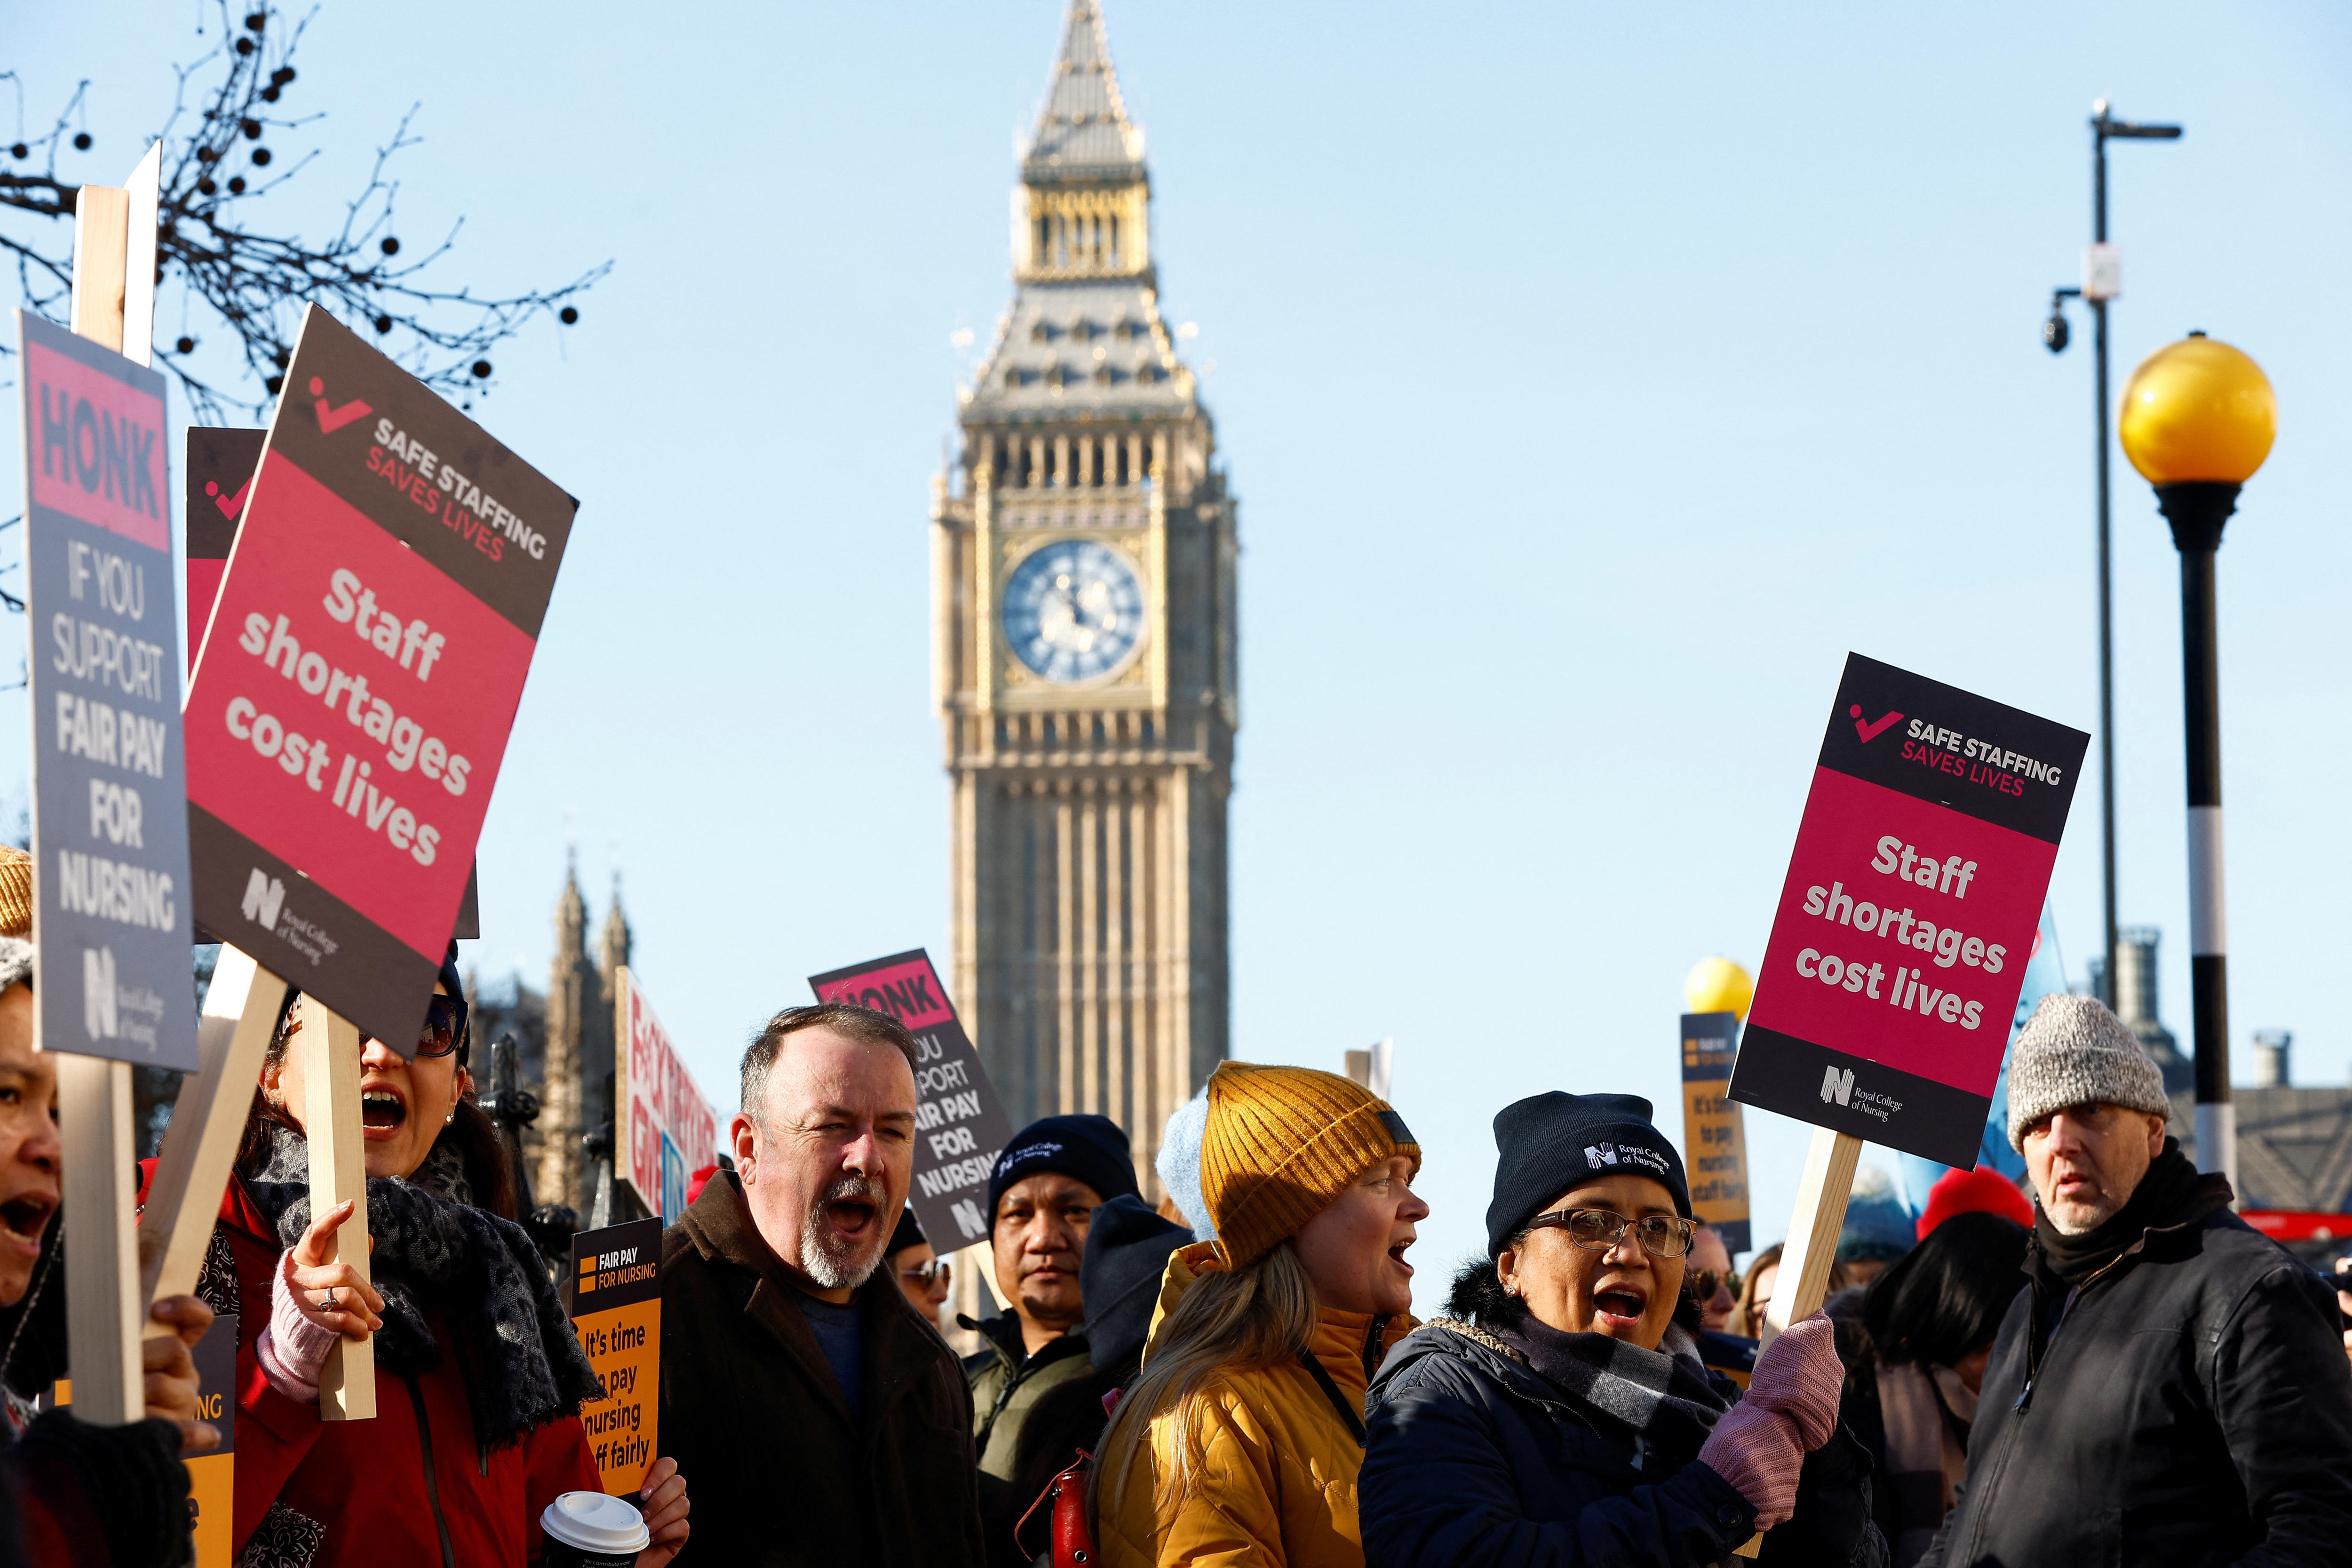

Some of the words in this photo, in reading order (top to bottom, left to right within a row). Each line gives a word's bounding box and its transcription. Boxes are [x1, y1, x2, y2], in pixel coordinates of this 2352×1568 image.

[40, 382, 161, 520] HONK
[366, 446, 441, 513] SAVES
[441, 501, 505, 562] LIVES
[374, 418, 438, 480] SAFE
[437, 465, 547, 560] STAFFING
[67, 539, 90, 601] IF
[93, 548, 144, 621] YOU
[323, 568, 446, 682] Staff
[53, 612, 164, 703] SUPPORT
[238, 612, 472, 796] shortages
[55, 690, 118, 767] FAIR
[119, 709, 166, 779] PAY
[1907, 718, 1964, 752] SAFE
[1963, 738, 2062, 786] STAFFING
[225, 697, 330, 792] cost
[332, 754, 441, 867] lives
[1900, 741, 1966, 776] SAVES
[1970, 764, 2025, 797] LIVES
[89, 777, 143, 849] FOR
[58, 850, 175, 933] NURSING
[1871, 835, 1978, 899] Staff
[1803, 881, 2007, 974] shortages
[832, 975, 940, 1022] ONK
[1796, 947, 1884, 999] cost
[1890, 967, 1984, 1030] lives
[915, 1034, 943, 1062] OU
[914, 1102, 946, 1131] AIR
[939, 1089, 982, 1122] PAY
[1851, 1101, 1861, 1109] of
[1861, 1103, 1889, 1122] Nursing
[1855, 1087, 1875, 1102] Royal
[1876, 1094, 1903, 1112] College
[928, 1127, 978, 1161] FOR
[1619, 1145, 1644, 1156] Royal
[1635, 1156, 1665, 1175] Nursing
[916, 1149, 1002, 1198] NURSIN
[599, 1251, 619, 1270] FAIR
[620, 1247, 638, 1266] PAY
[599, 1271, 616, 1289] FOR
[618, 1262, 656, 1285] NURSING
[586, 1329, 606, 1358] It's
[611, 1321, 645, 1352] time
[611, 1365, 637, 1398] pay
[585, 1399, 641, 1436] nursing
[611, 1434, 650, 1468] fairly
